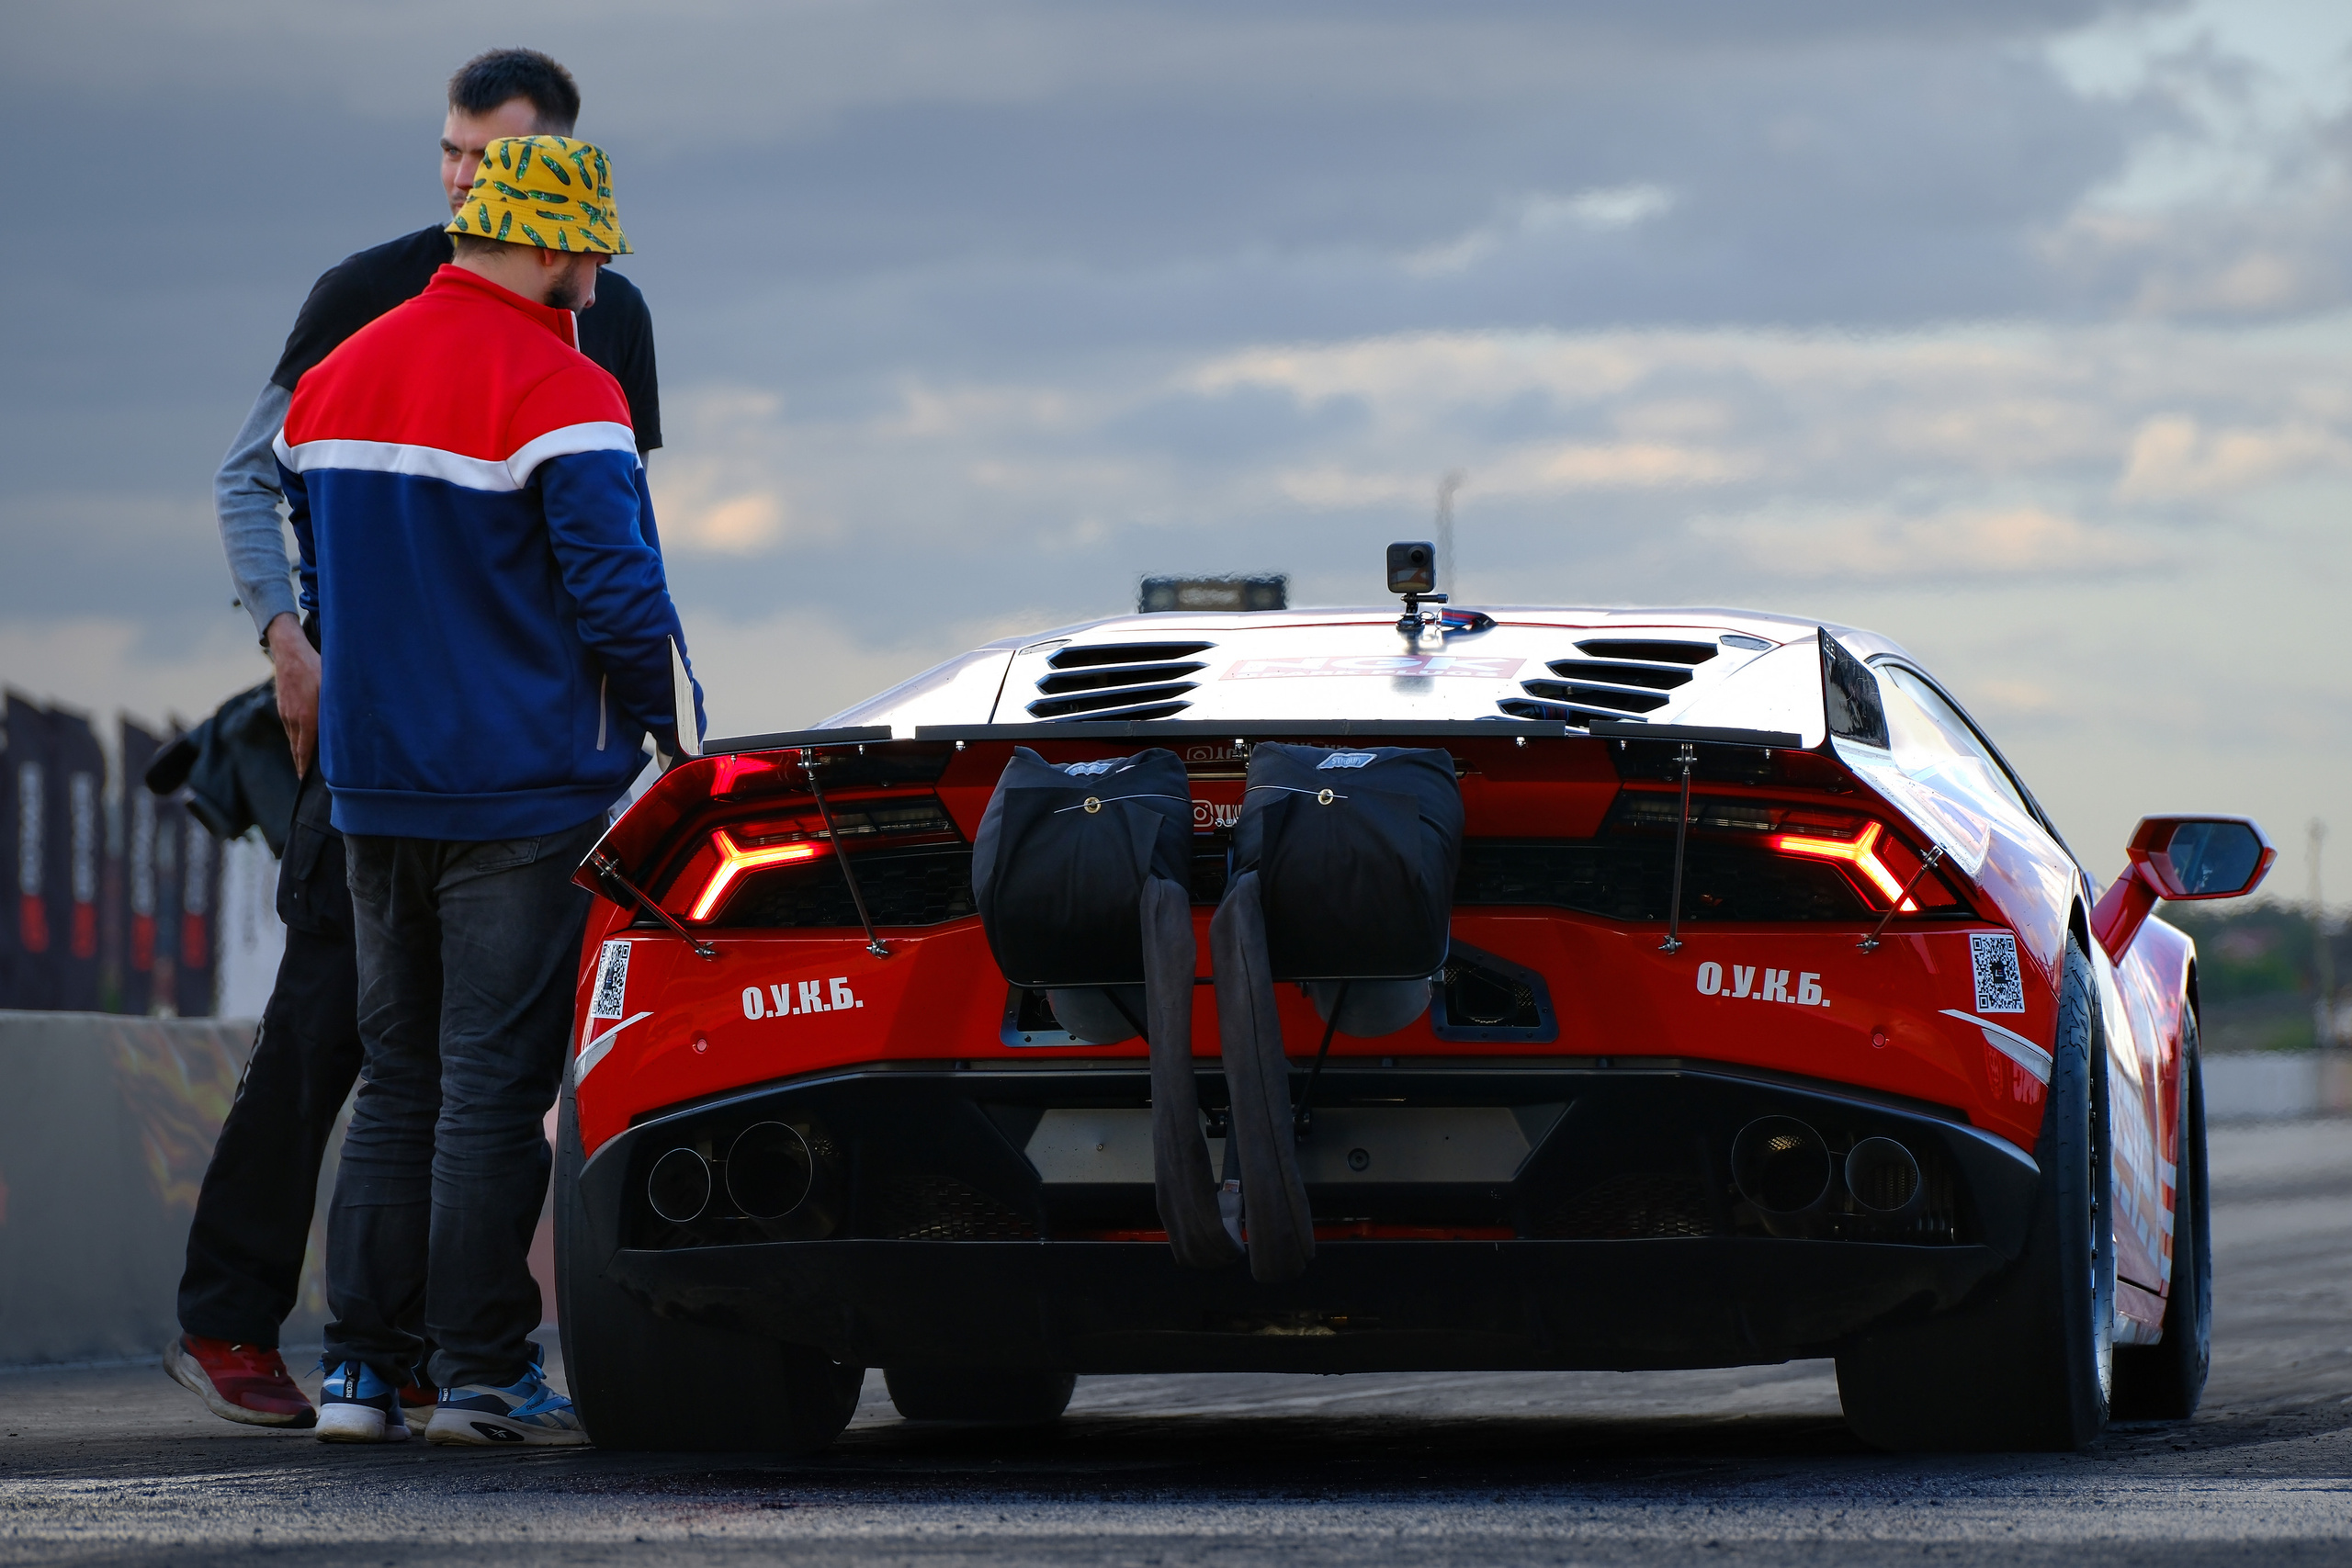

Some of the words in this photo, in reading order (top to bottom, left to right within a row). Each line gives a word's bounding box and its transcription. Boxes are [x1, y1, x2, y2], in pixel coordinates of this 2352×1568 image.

[1238, 657, 1510, 673] NGK
[741, 976, 864, 1020] О.У.К.Б.
[1696, 961, 1830, 1007] О.У.К.Б.
